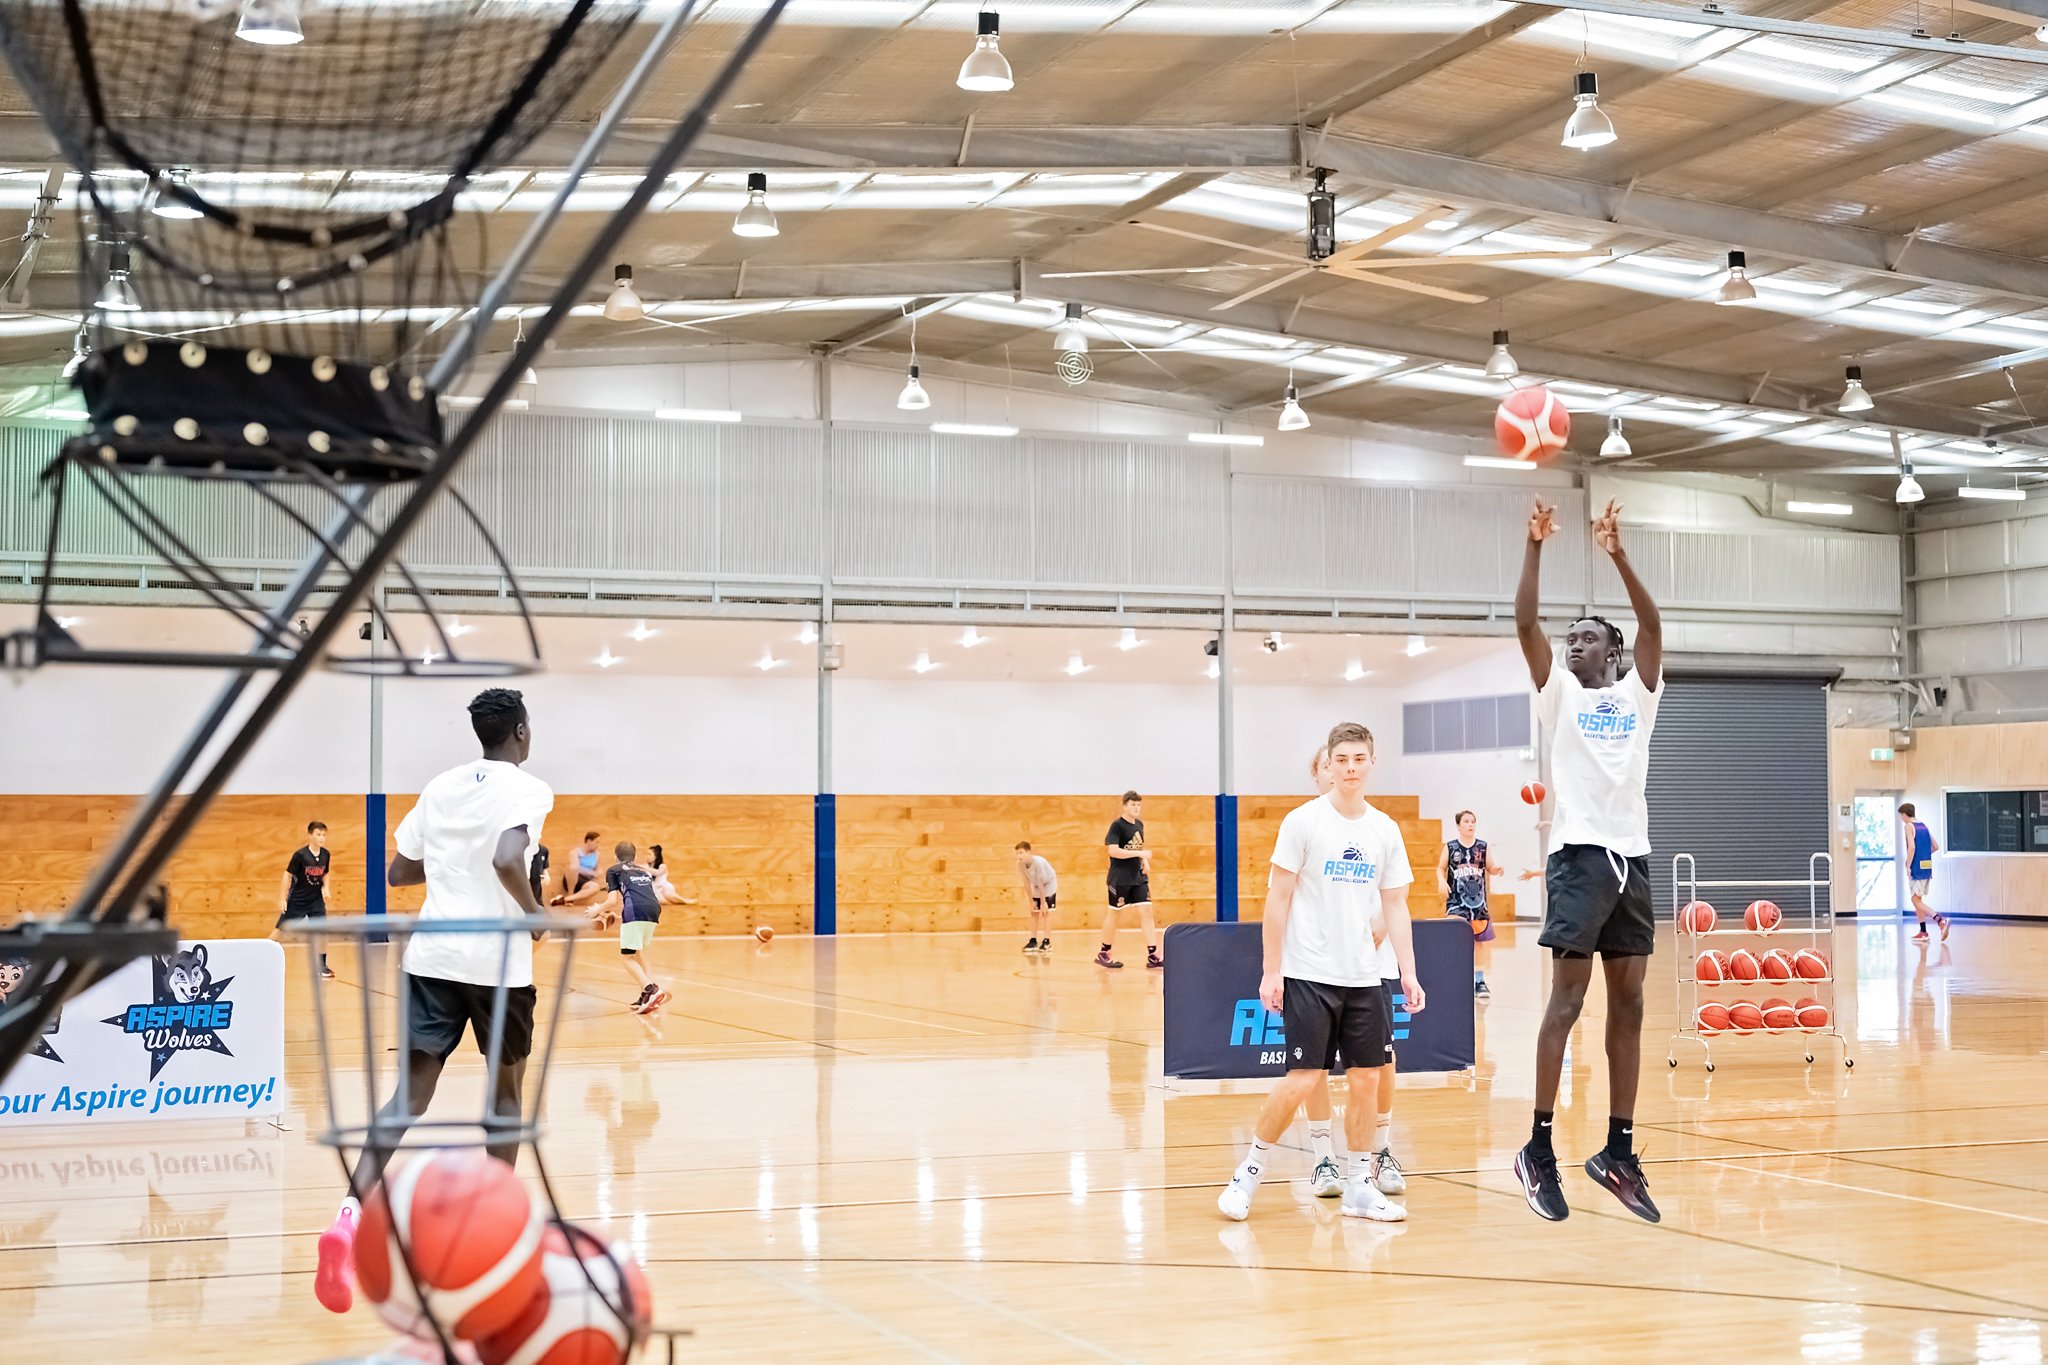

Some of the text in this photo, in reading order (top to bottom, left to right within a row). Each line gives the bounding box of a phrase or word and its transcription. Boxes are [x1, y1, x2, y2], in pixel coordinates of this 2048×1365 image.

[1577, 712, 1636, 733] ASPIRE
[1323, 860, 1376, 879] ASPIRE
[126, 1003, 231, 1031] ASPIRE
[145, 1028, 213, 1049] Wolves
[51, 1083, 147, 1117] Aspire
[150, 1077, 276, 1114] journey!
